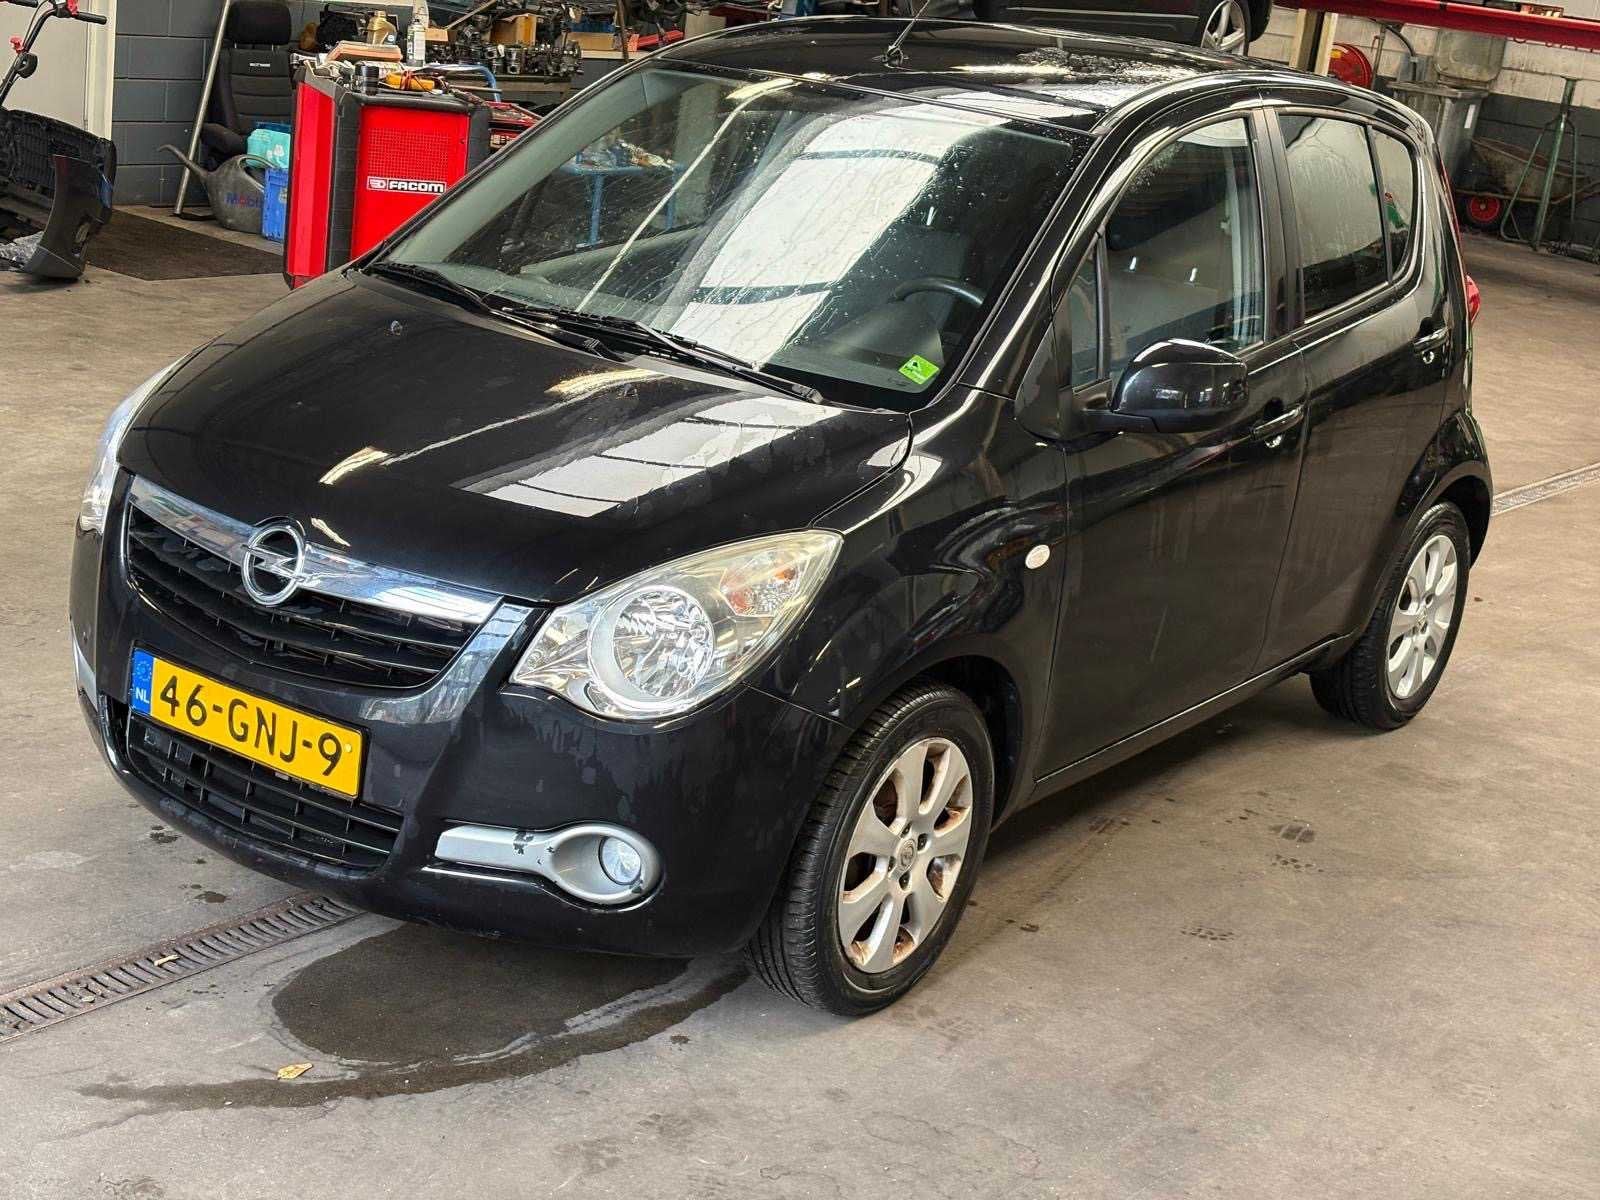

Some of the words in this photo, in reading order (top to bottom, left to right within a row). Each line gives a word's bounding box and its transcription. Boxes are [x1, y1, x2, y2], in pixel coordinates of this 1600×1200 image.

[389, 180, 444, 193] FACOM
[135, 687, 150, 704] NL
[160, 675, 343, 777] 46-GNJ-9
